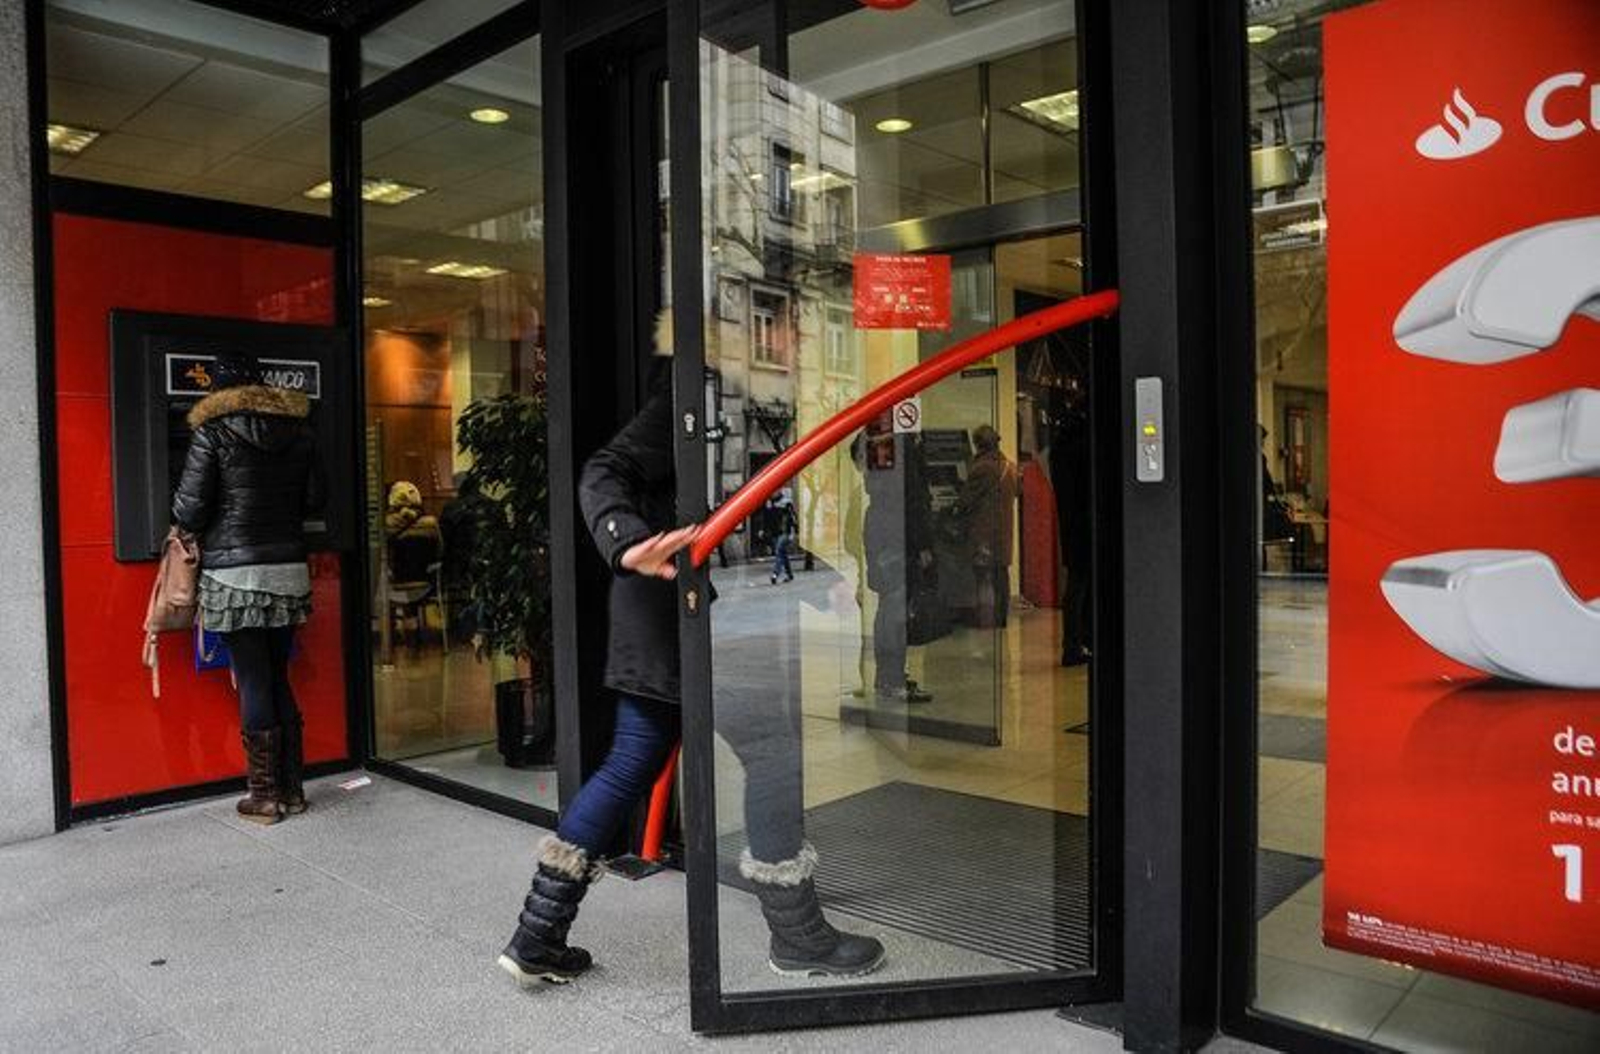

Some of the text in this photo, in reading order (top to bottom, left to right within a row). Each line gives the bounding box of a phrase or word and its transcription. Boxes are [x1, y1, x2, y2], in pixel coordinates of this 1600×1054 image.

[260, 370, 304, 389] ANCO
[1553, 725, 1596, 757] de
[1549, 809, 1583, 826] para
[1551, 843, 1582, 903] 1
